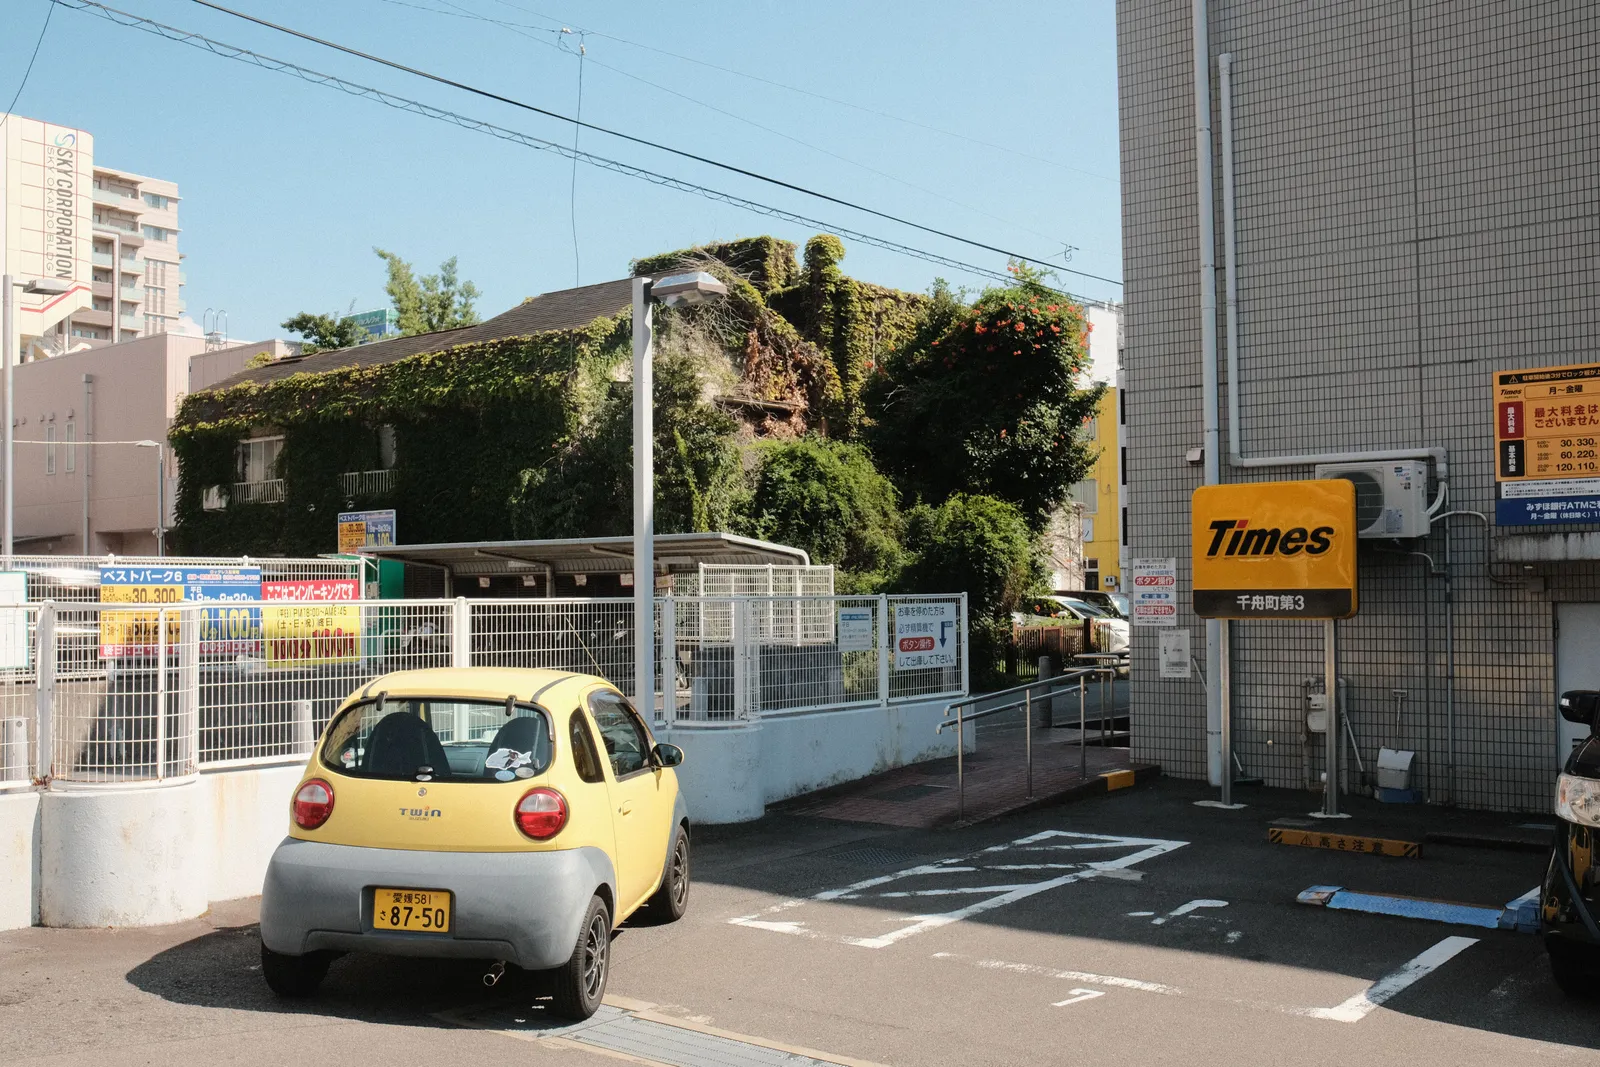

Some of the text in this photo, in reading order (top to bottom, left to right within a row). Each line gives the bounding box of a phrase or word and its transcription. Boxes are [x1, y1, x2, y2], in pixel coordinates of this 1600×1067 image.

[46, 146, 55, 174] SKY
[55, 147, 73, 280] SKY CORPORATION
[46, 232, 55, 272] BLDG
[1500, 388, 1522, 396] Times
[1534, 404, 1599, 419] 最大料金は
[1534, 415, 1600, 429] ございません
[1206, 519, 1334, 556] Times
[103, 570, 183, 583] ベストパーク6
[1136, 577, 1173, 586] ボタン操作
[1236, 595, 1305, 611] 千舟町第3
[898, 606, 945, 617] お車を停めた方は
[902, 640, 932, 650] ボタン操作
[1318, 836, 1385, 853] 高さ注意
[390, 905, 445, 929] 87-50
